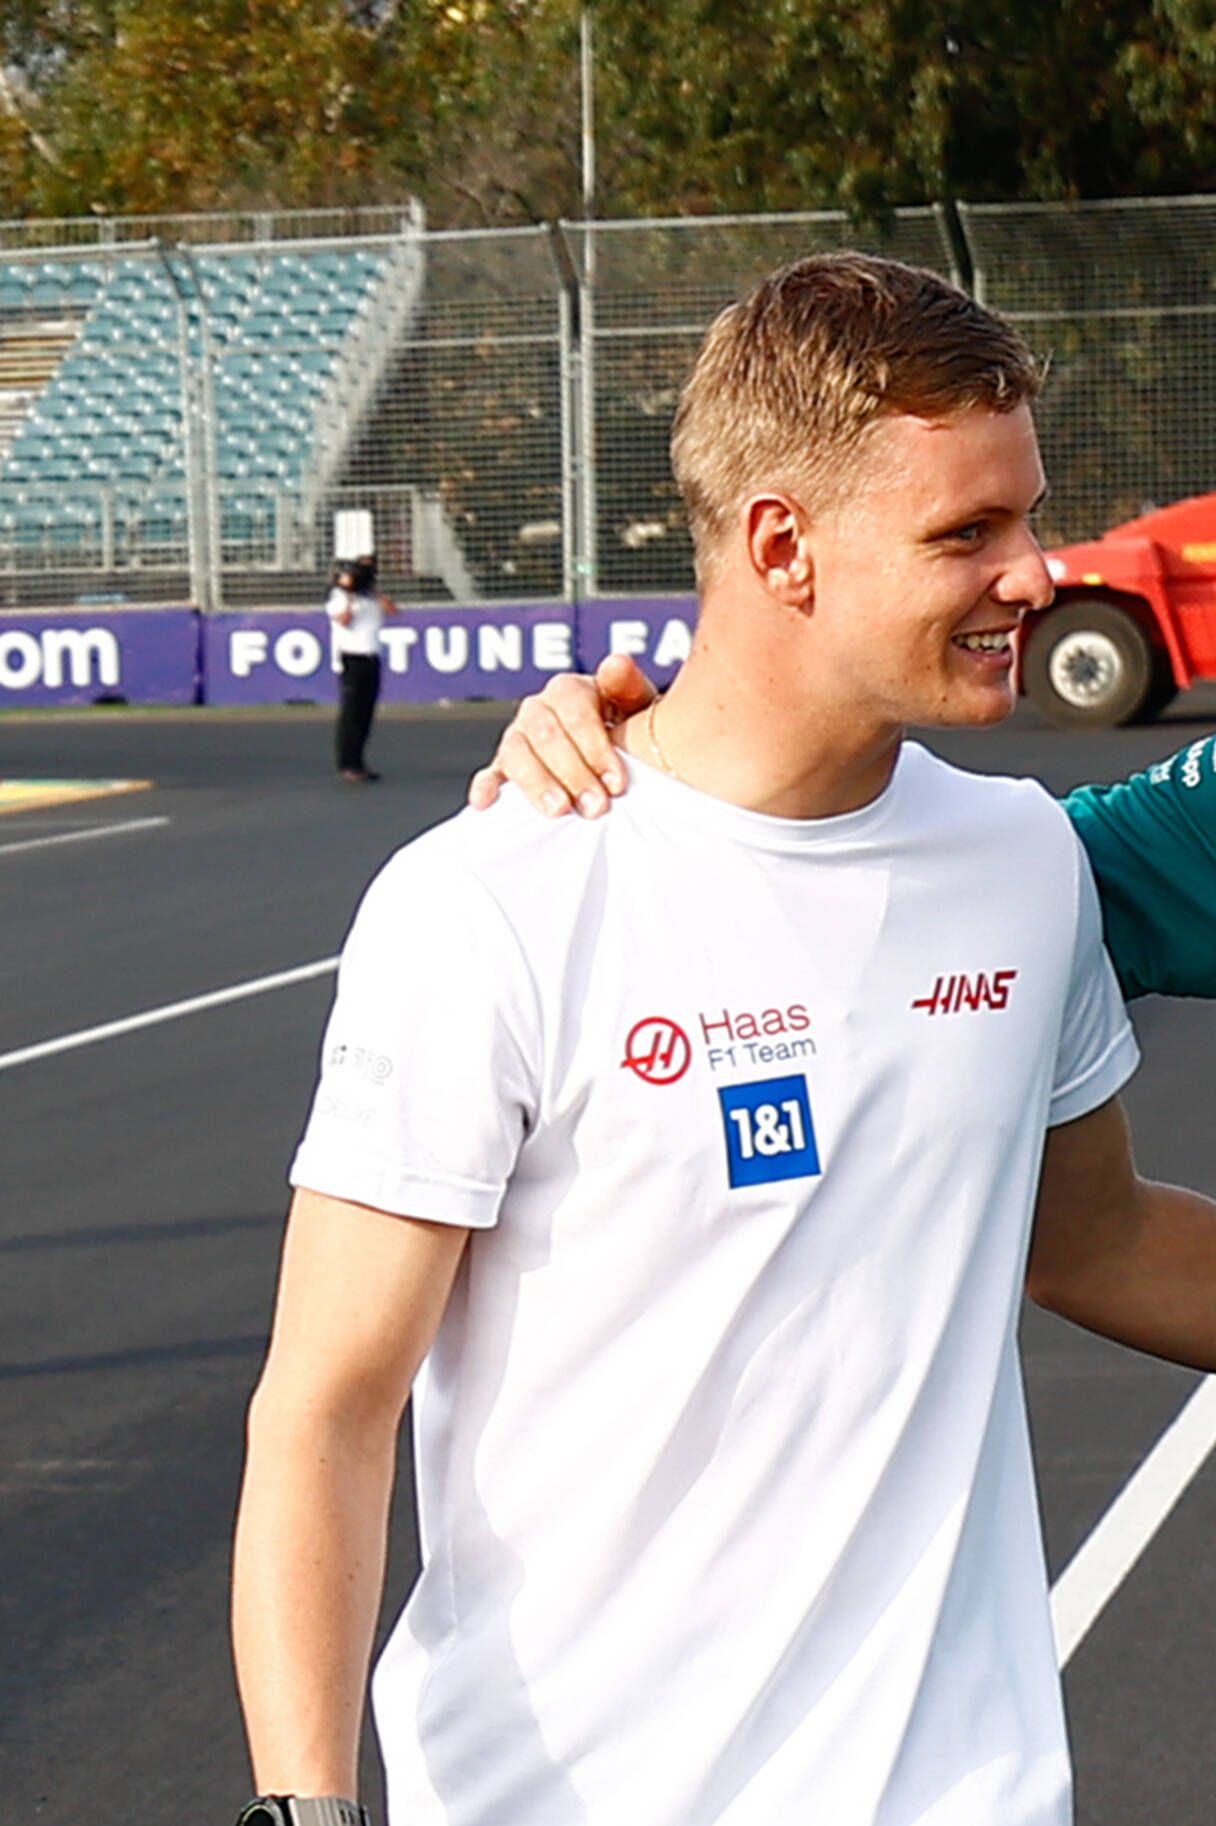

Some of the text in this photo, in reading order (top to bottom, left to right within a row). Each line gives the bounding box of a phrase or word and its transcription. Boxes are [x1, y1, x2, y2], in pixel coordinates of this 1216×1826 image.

[230, 623, 573, 677] FOTUNE
[911, 970, 1018, 1016] HAAS
[699, 1004, 811, 1046] Haas
[707, 1037, 817, 1071] F1 Team
[730, 1099, 806, 1159] 1&1
